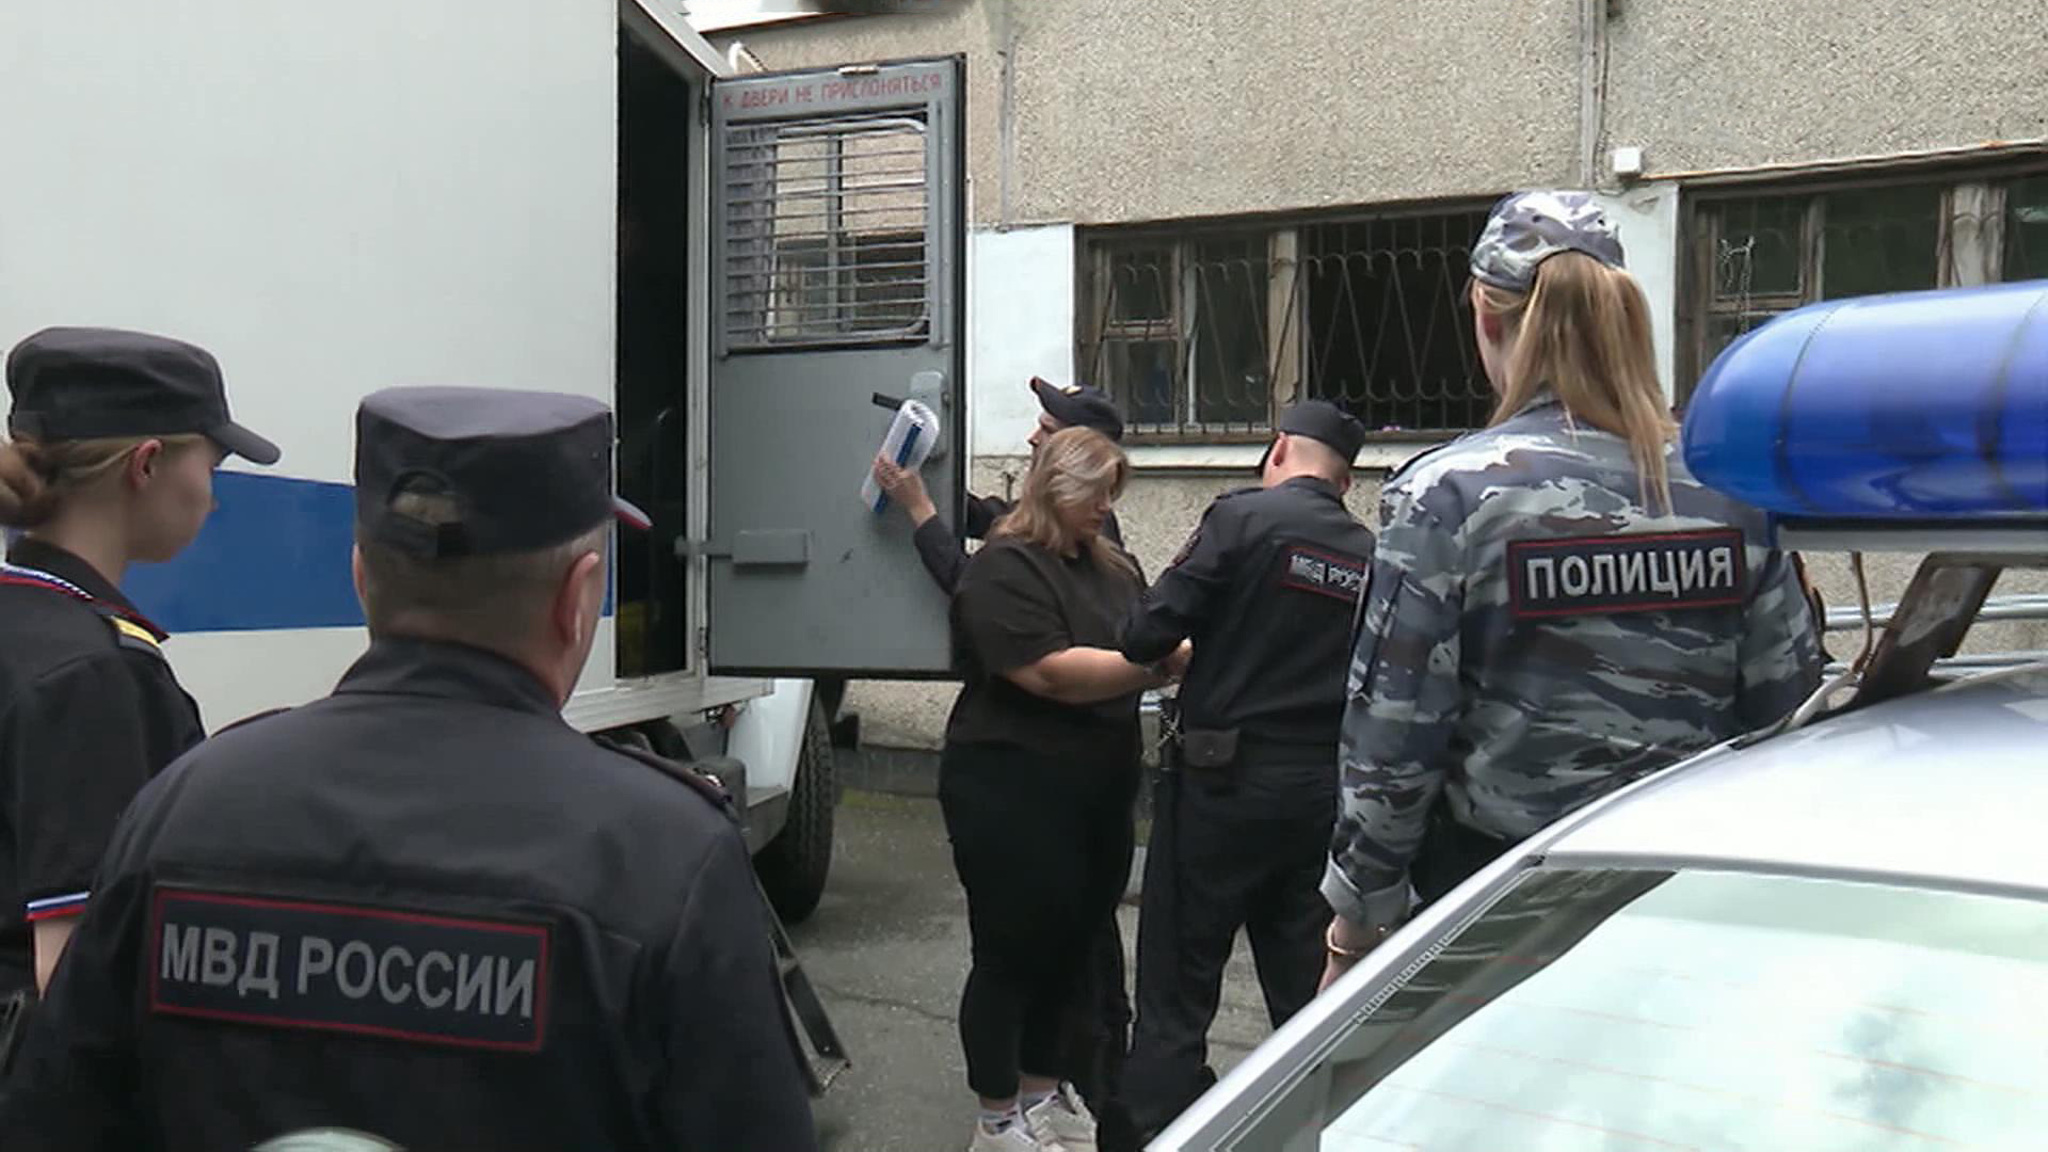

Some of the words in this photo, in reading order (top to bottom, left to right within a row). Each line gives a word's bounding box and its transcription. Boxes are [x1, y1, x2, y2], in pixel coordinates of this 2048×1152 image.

[722, 93, 732, 108] К
[742, 86, 788, 109] ДВЕРИ
[796, 86, 812, 103] НЕ
[821, 73, 942, 100] ПРИСЛОНЯТЬСЯ
[1527, 547, 1734, 599] ПОЛИЦИЯ
[161, 922, 280, 1000] МВД
[297, 935, 536, 1018] РОССИИ
